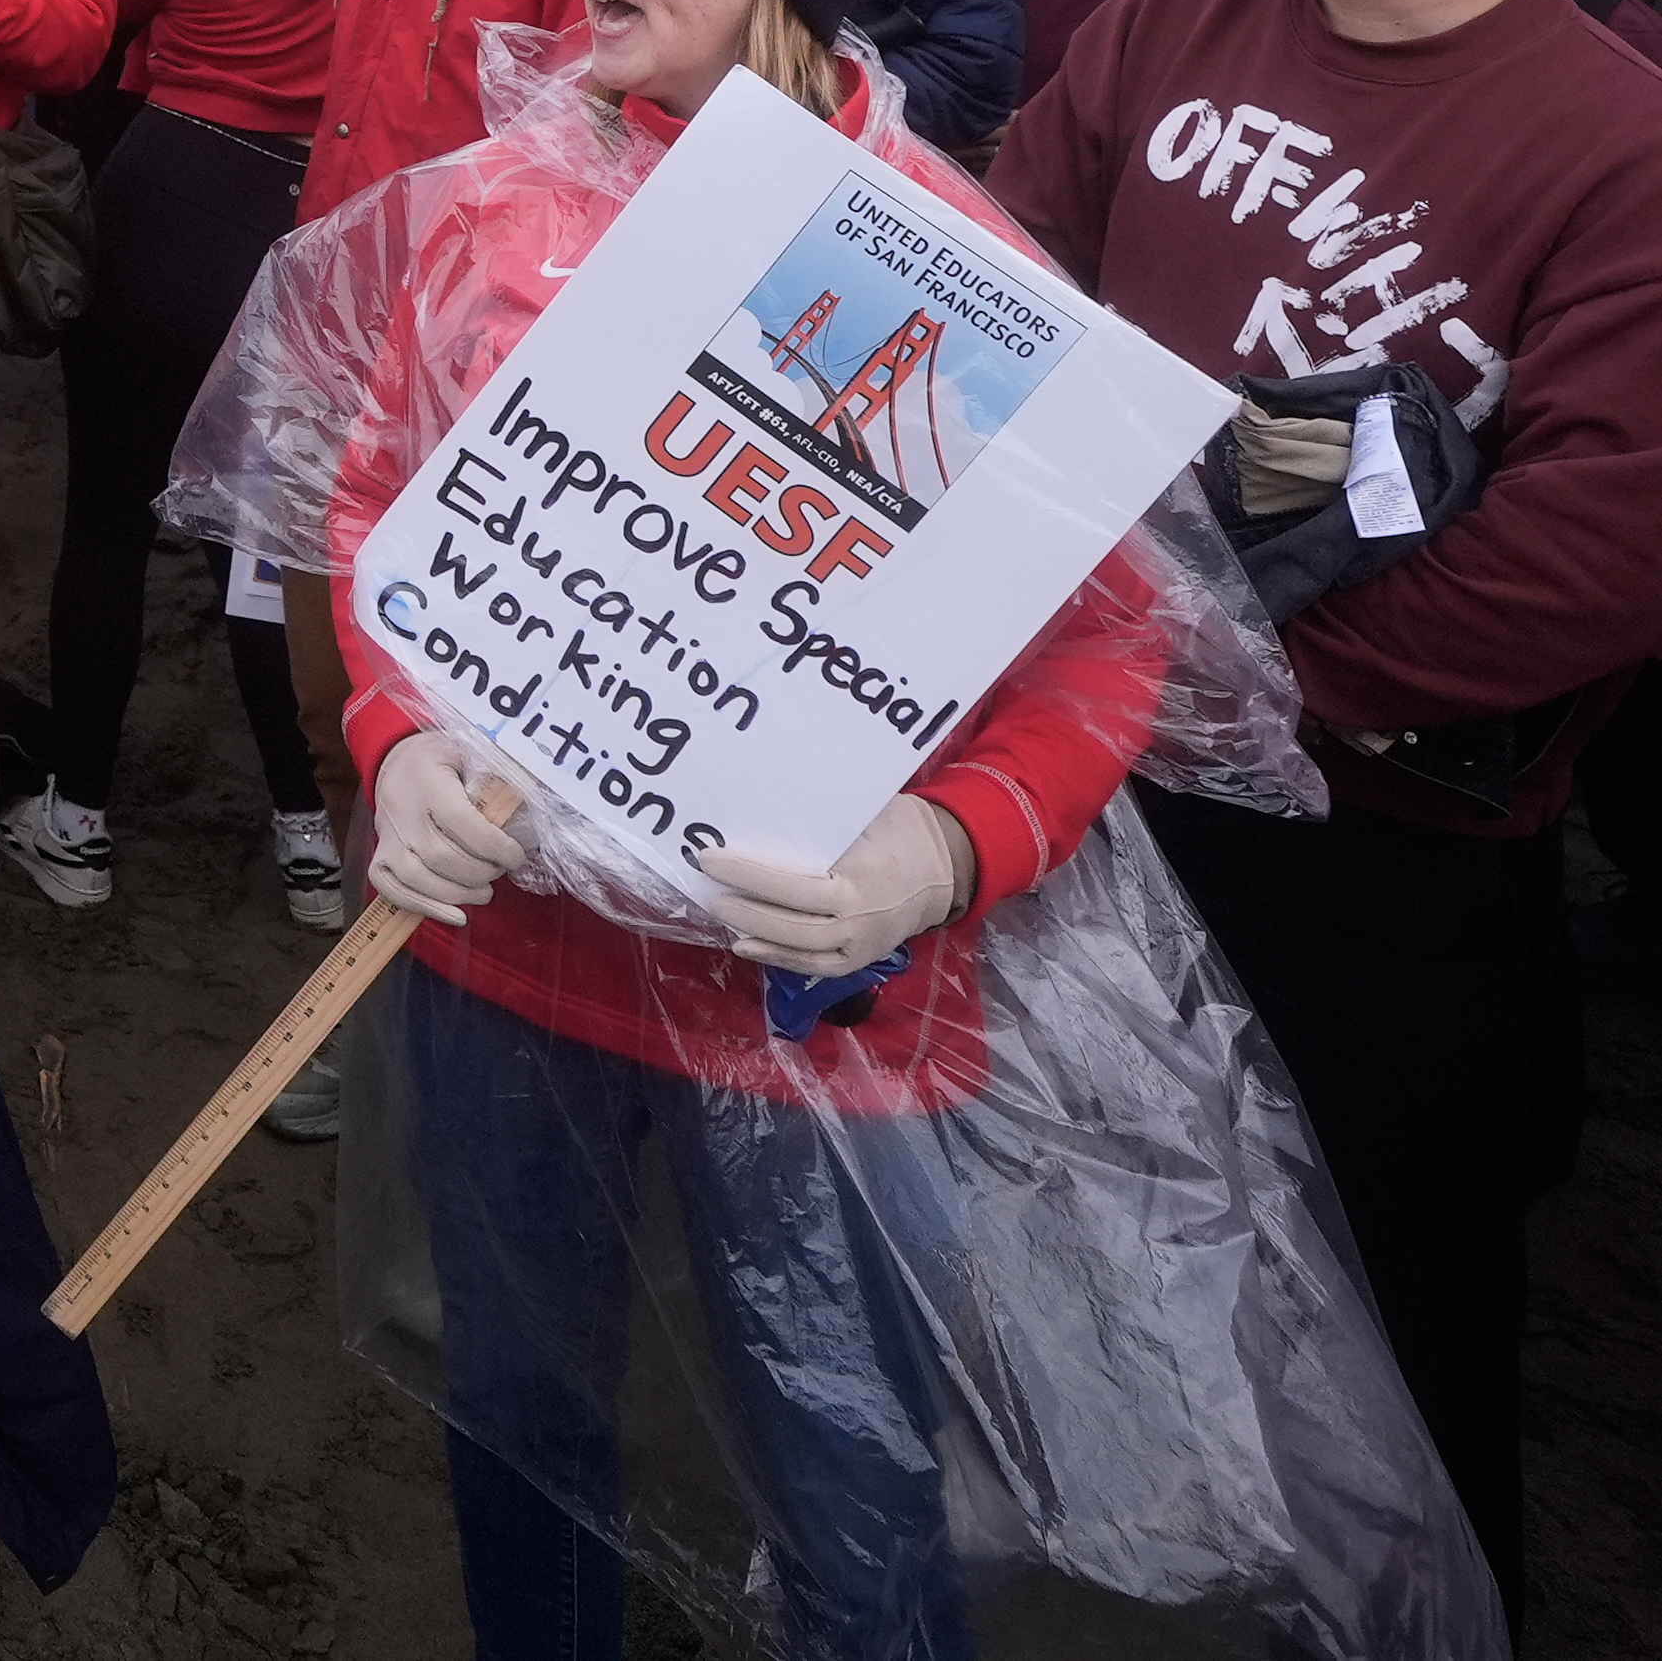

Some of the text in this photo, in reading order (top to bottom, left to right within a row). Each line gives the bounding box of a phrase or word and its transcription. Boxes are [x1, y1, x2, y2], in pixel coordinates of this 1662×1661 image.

[834, 217, 1036, 360] OF SAN FRANCISCO
[846, 190, 1061, 344] UNITED EDUCATORS
[642, 389, 896, 590] UESF
[707, 369, 762, 412] AFT/CFT
[792, 433, 842, 474] AFL-CIO,
[845, 469, 904, 516] NEA/CTA
[429, 530, 692, 777] Working
[435, 449, 762, 734] Education
[489, 377, 964, 754] Improve Special
[377, 581, 729, 875] Conditions
